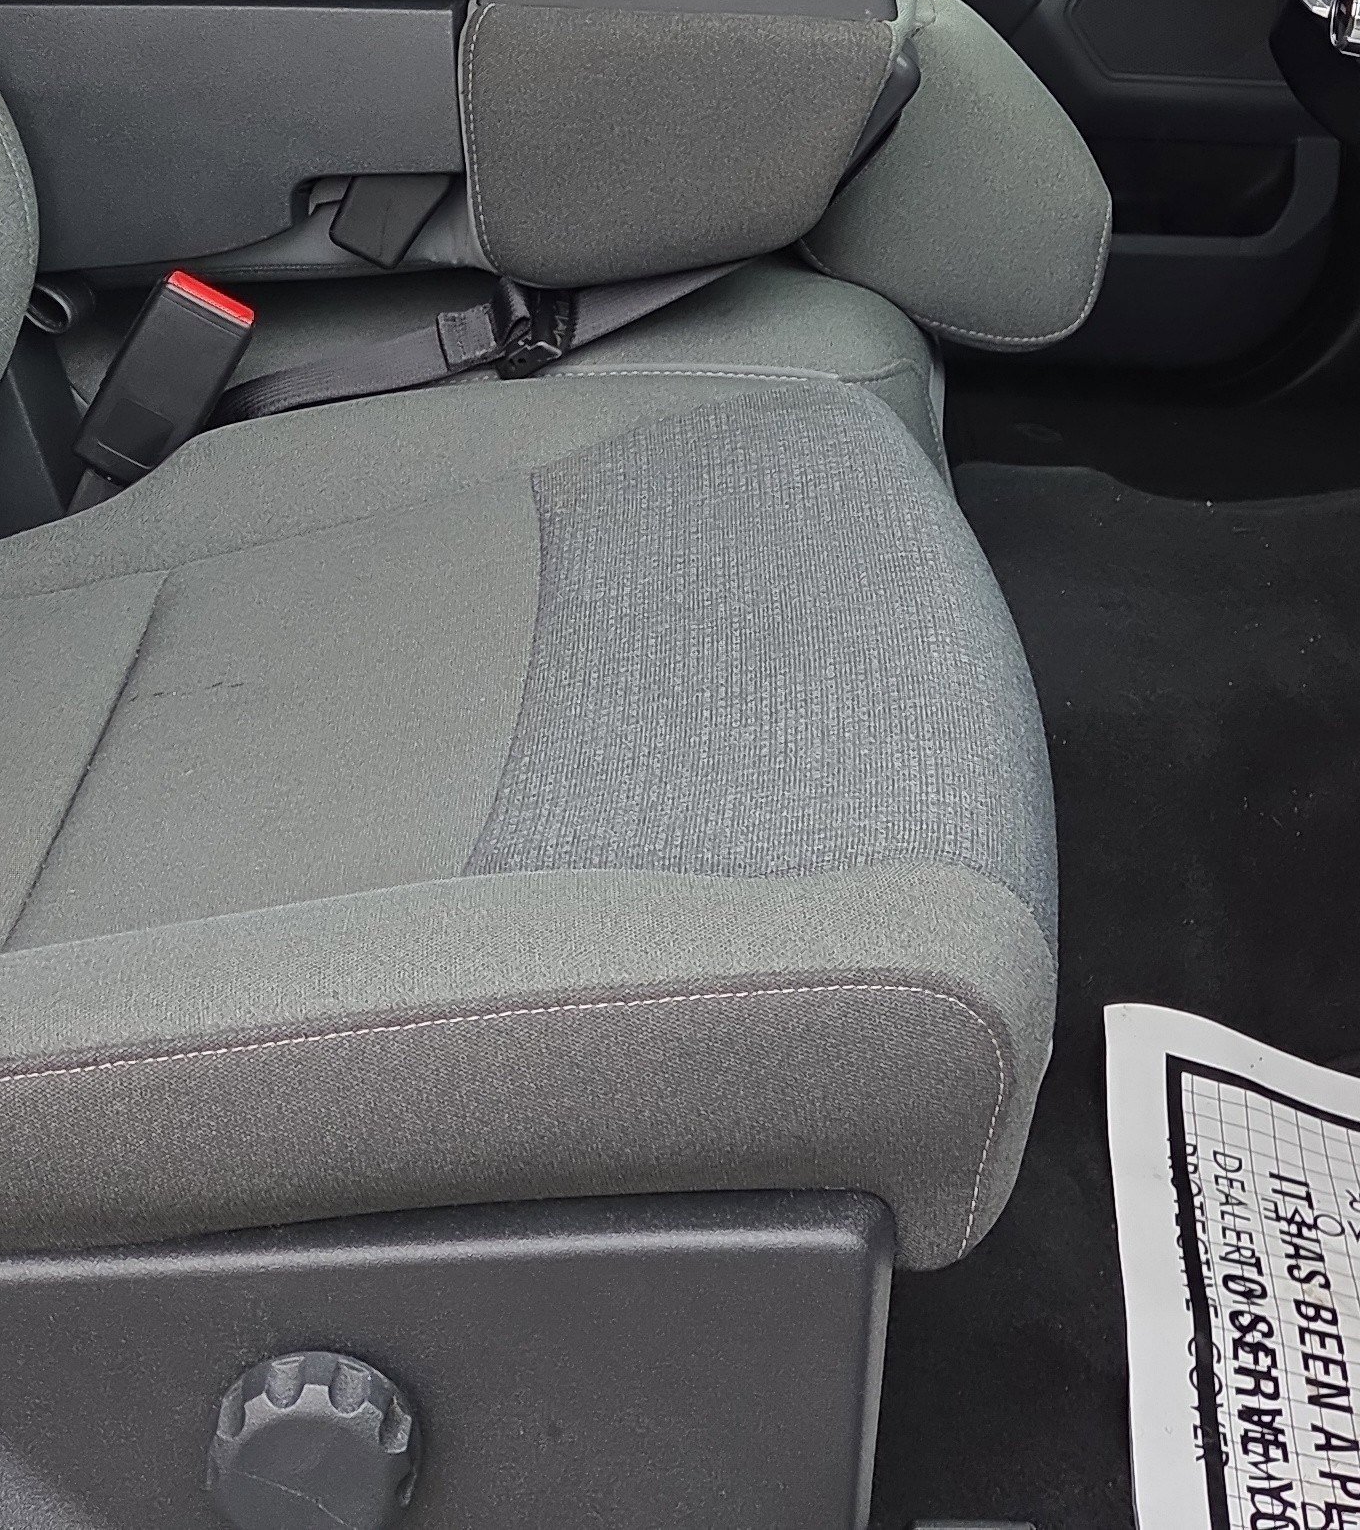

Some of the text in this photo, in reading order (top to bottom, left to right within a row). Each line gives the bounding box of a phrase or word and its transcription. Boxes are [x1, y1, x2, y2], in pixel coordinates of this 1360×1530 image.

[1211, 1150, 1256, 1262] DEALER
[1269, 1170, 1315, 1210] IT
[1219, 1254, 1268, 1301] TO
[1277, 1216, 1332, 1292] HAS
[1228, 1308, 1290, 1464] SERVE
[1293, 1297, 1354, 1415] BEEN
[1310, 1422, 1360, 1452] A
